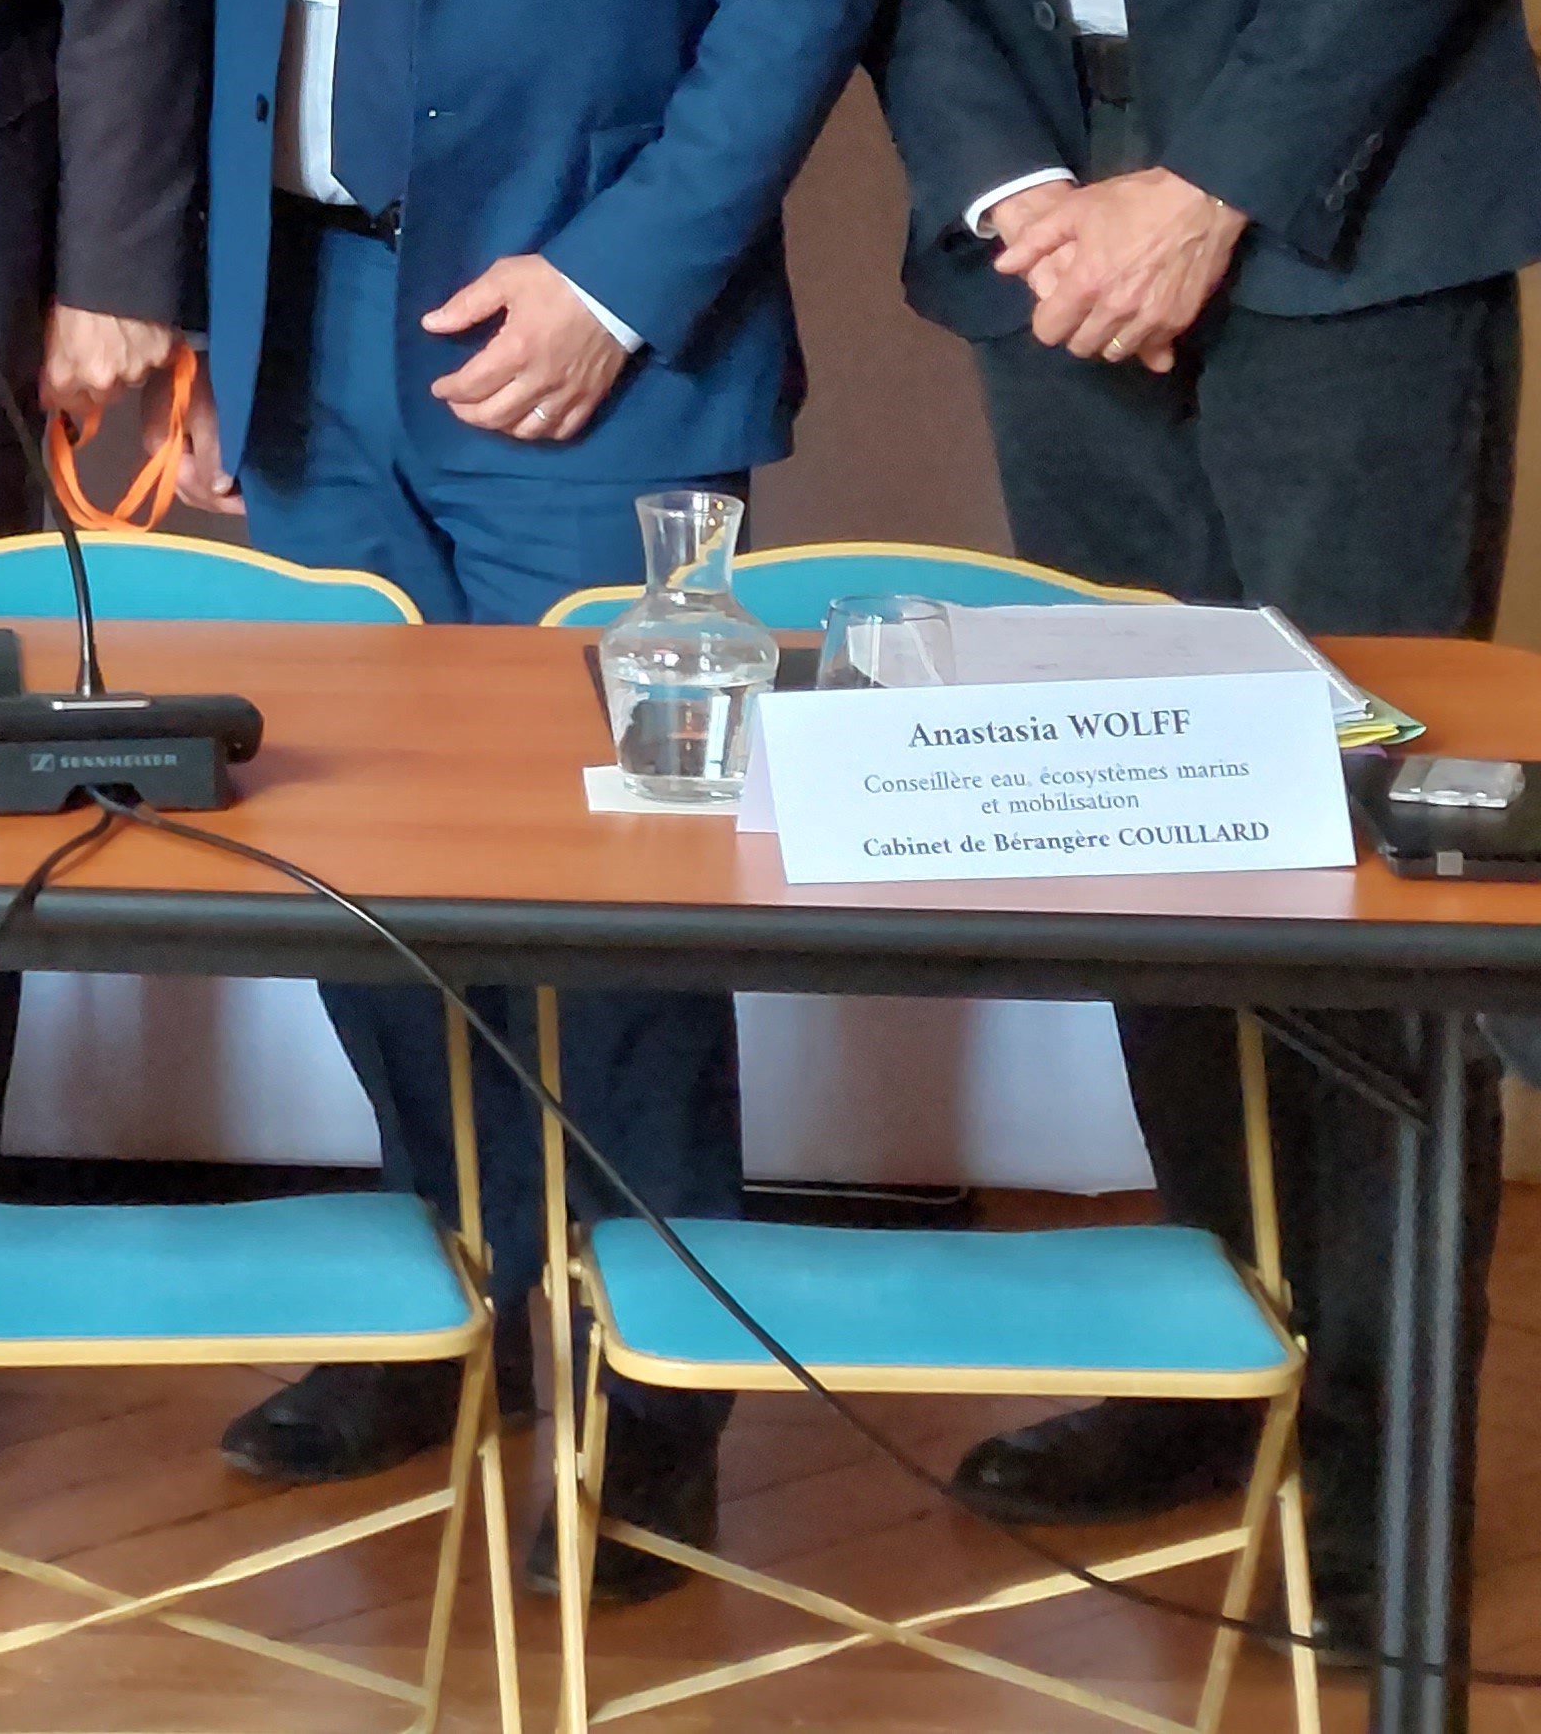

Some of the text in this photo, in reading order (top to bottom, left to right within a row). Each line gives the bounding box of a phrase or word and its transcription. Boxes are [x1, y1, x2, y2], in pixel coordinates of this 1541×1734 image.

[908, 709, 1191, 748] Anastasia WOLFF
[863, 770, 983, 794] Conseillère
[1039, 763, 1169, 789] écosystèmes
[1177, 759, 1250, 779] marins
[981, 791, 1140, 814] et mobilisation
[863, 821, 1270, 857] Cabinet de Bérangère COUILLARD
